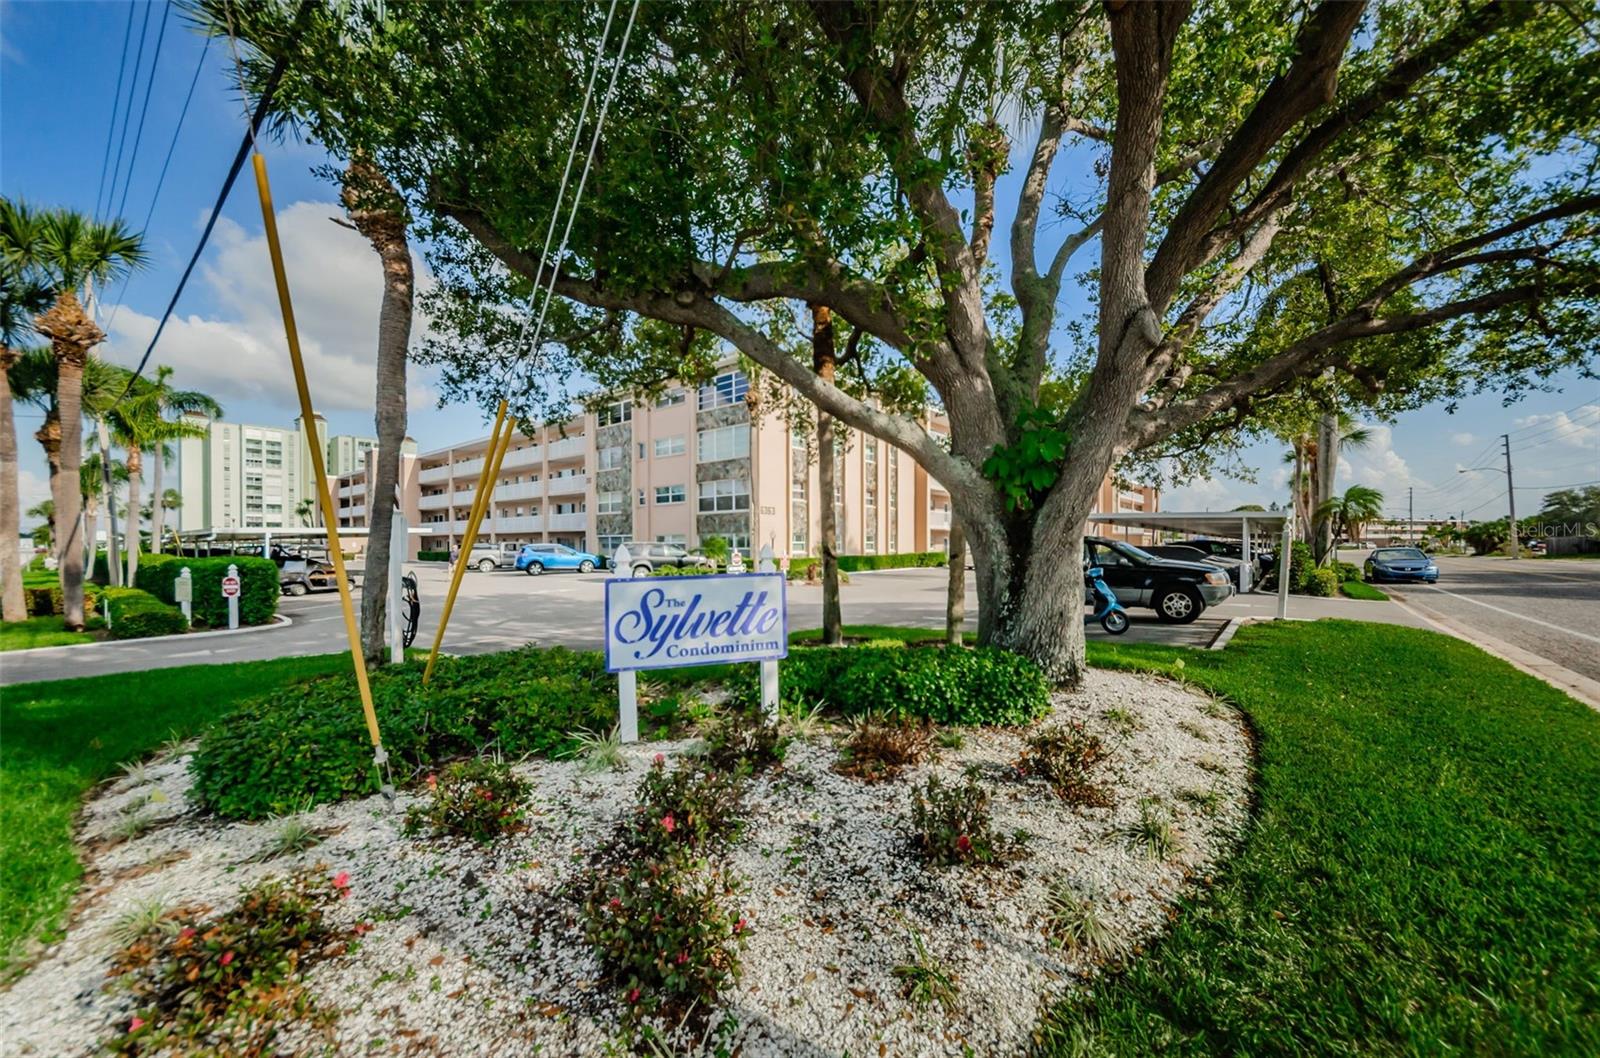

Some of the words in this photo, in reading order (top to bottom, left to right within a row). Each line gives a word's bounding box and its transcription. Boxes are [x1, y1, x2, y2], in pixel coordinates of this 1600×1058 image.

[665, 598, 686, 608] The
[614, 588, 779, 660] Sylvette
[666, 640, 779, 659] Condominium
